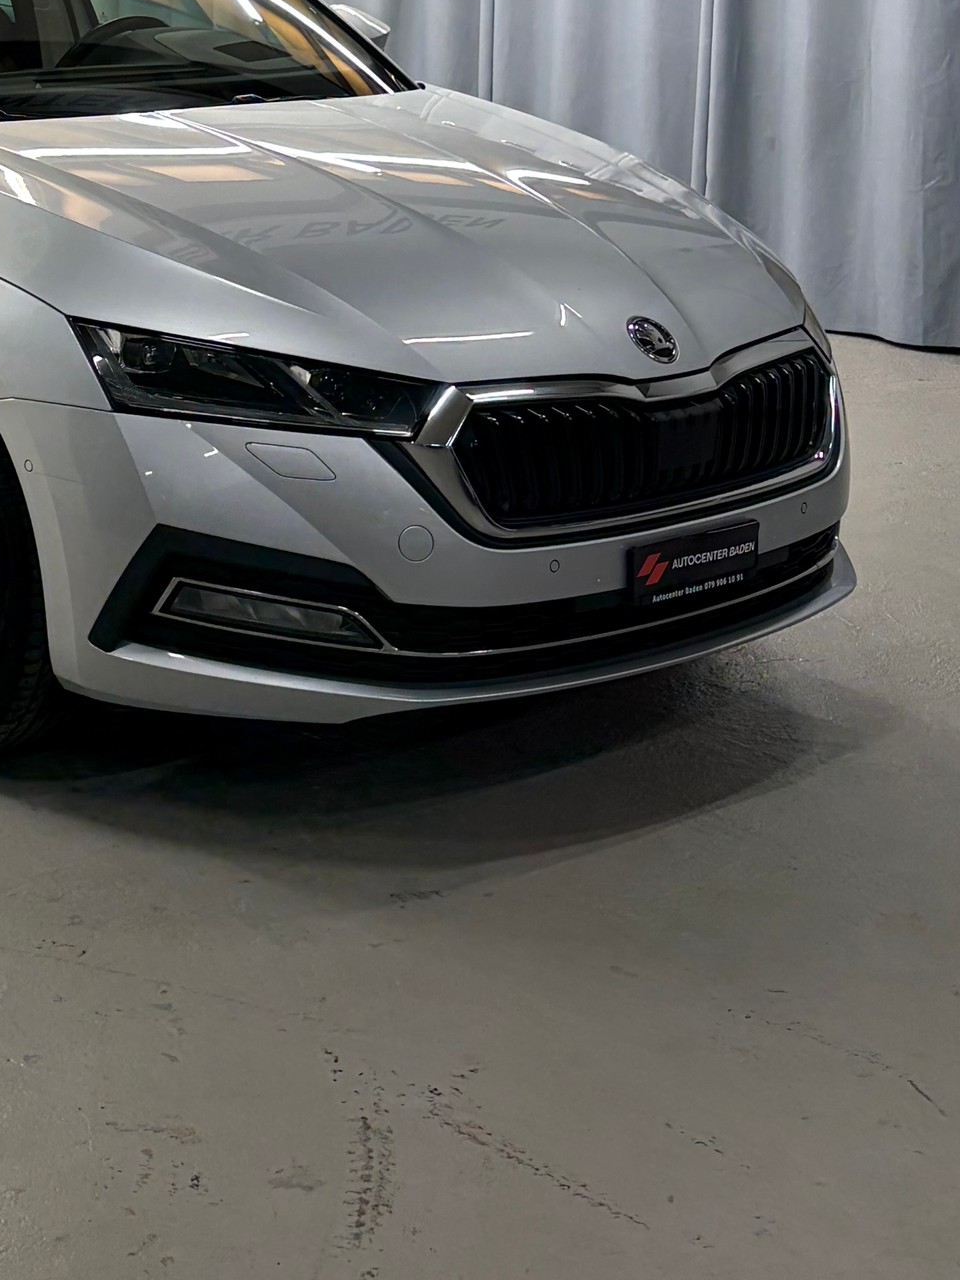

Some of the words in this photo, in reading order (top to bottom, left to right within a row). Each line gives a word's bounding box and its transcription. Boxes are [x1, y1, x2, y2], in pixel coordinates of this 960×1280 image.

[672, 548, 728, 569] AUTOCENTER
[729, 541, 755, 556] BADEN
[652, 589, 684, 603] Autocenter
[685, 585, 703, 595] Baden
[704, 580, 715, 590] 079
[736, 573, 743, 582] 91
